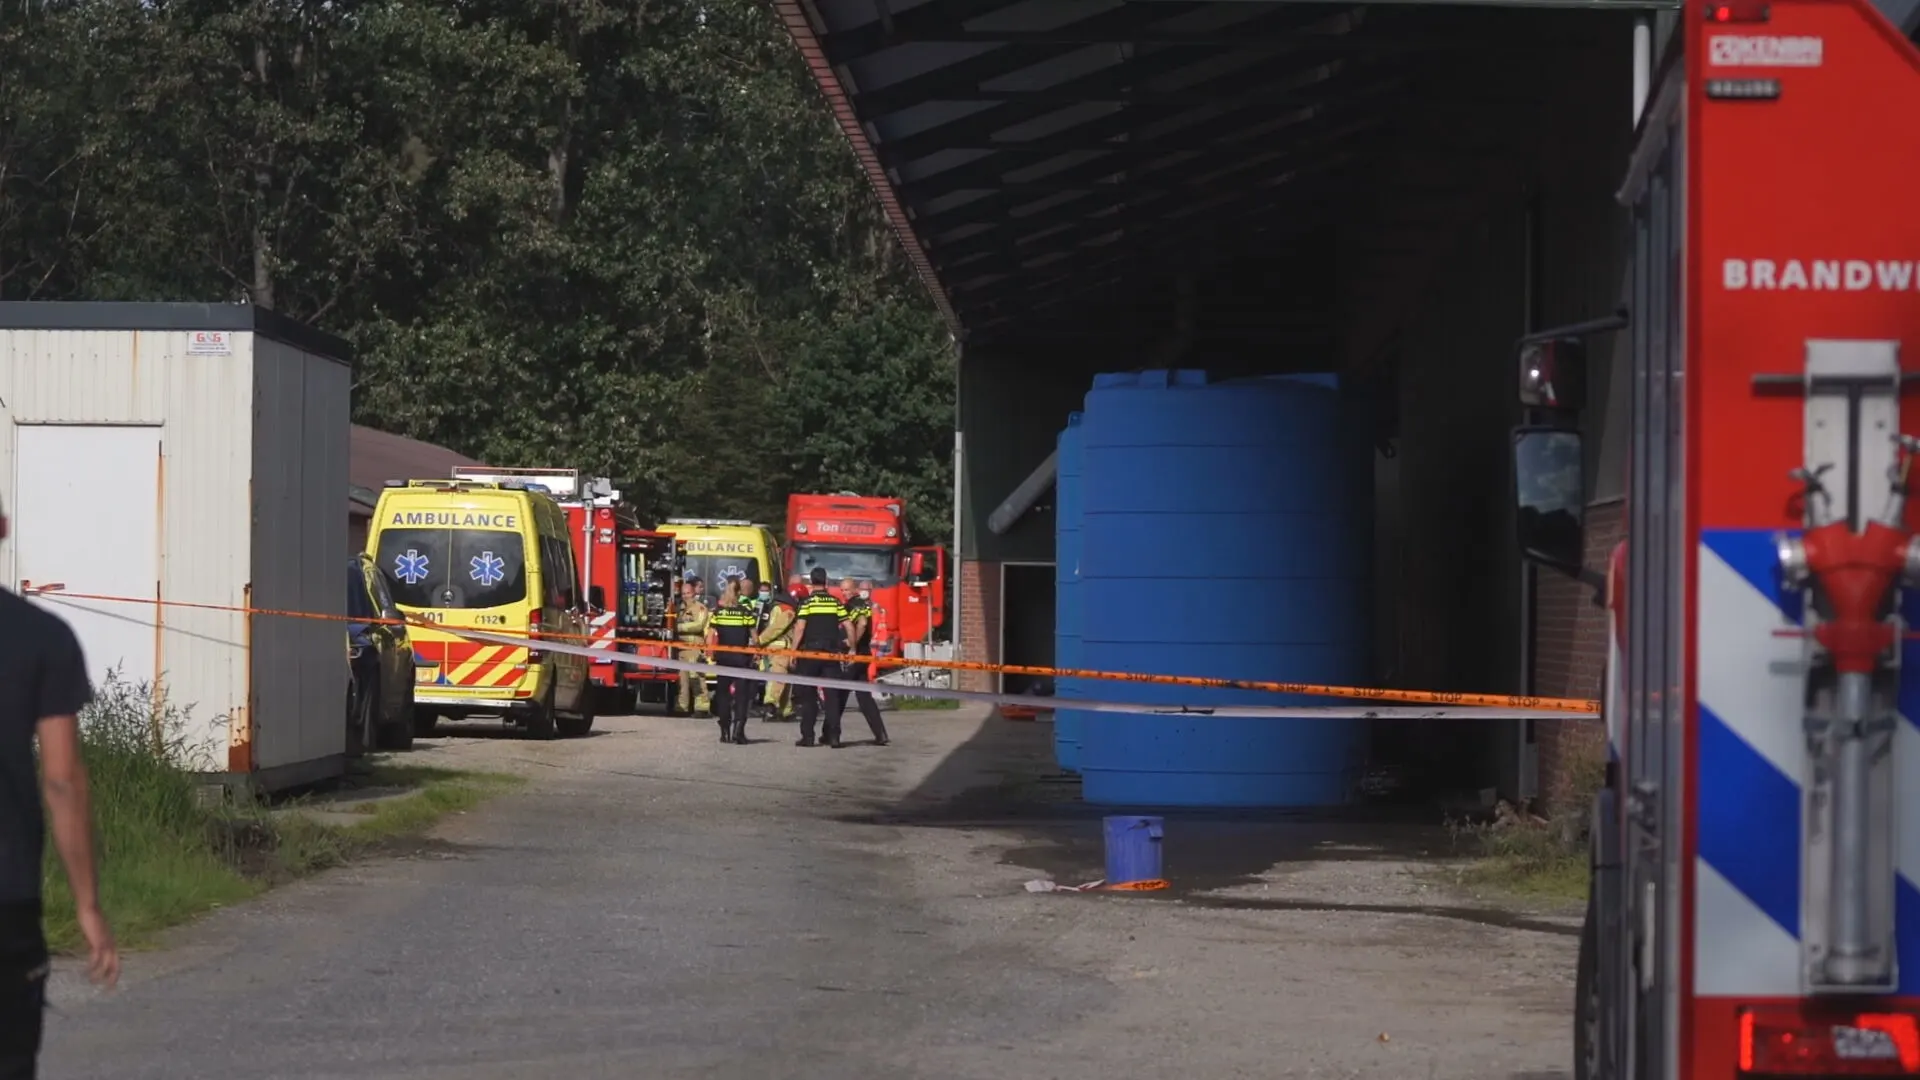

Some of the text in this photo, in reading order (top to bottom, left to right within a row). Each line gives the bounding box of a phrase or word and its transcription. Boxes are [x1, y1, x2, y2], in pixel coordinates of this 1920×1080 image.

[1723, 259, 1920, 291] BRANDW
[392, 512, 516, 528] AMBULANCE
[687, 541, 755, 554] BULANCE
[1353, 687, 1385, 698] STOP
[1430, 691, 1462, 703] STOP
[1507, 695, 1540, 708] STOP
